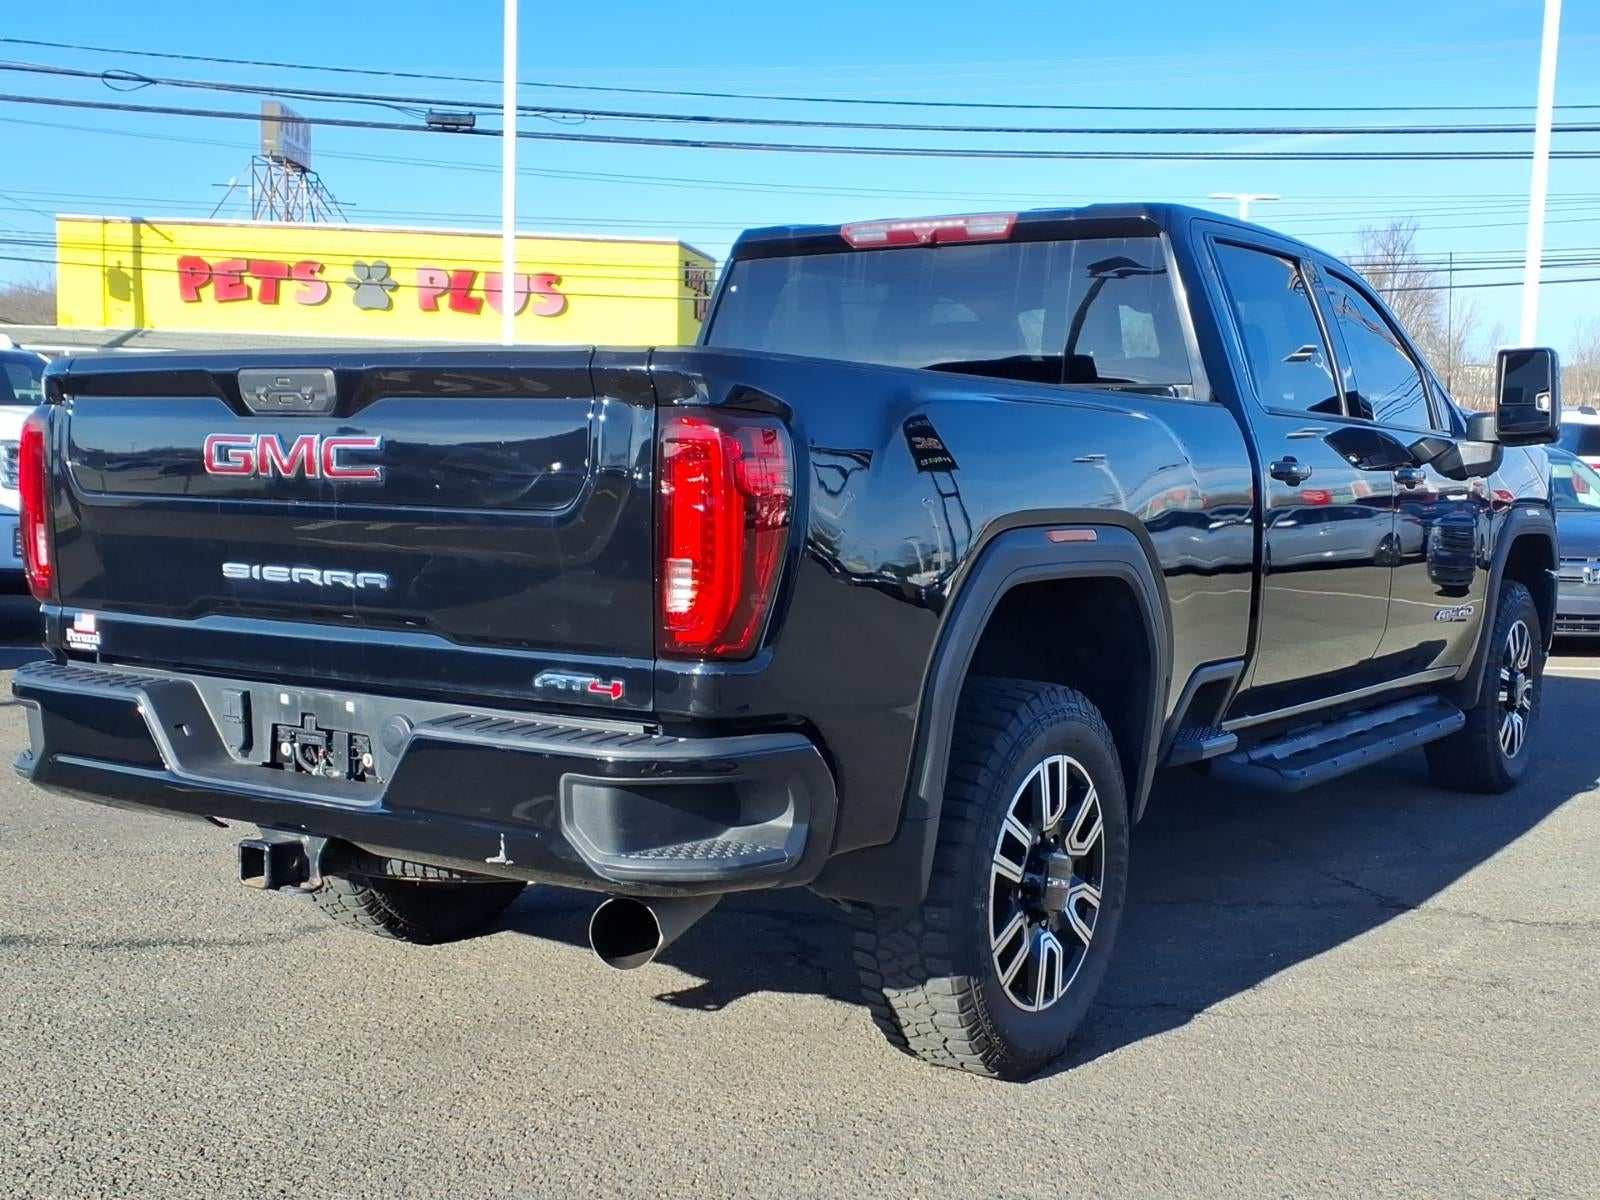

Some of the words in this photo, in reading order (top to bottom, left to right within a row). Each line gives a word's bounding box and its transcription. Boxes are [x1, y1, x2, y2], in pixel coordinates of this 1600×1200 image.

[177, 255, 331, 306] PETS
[416, 266, 568, 317] PLUS
[203, 432, 385, 483] GMC
[221, 562, 391, 590] SIERRA
[534, 672, 623, 700] AT4
